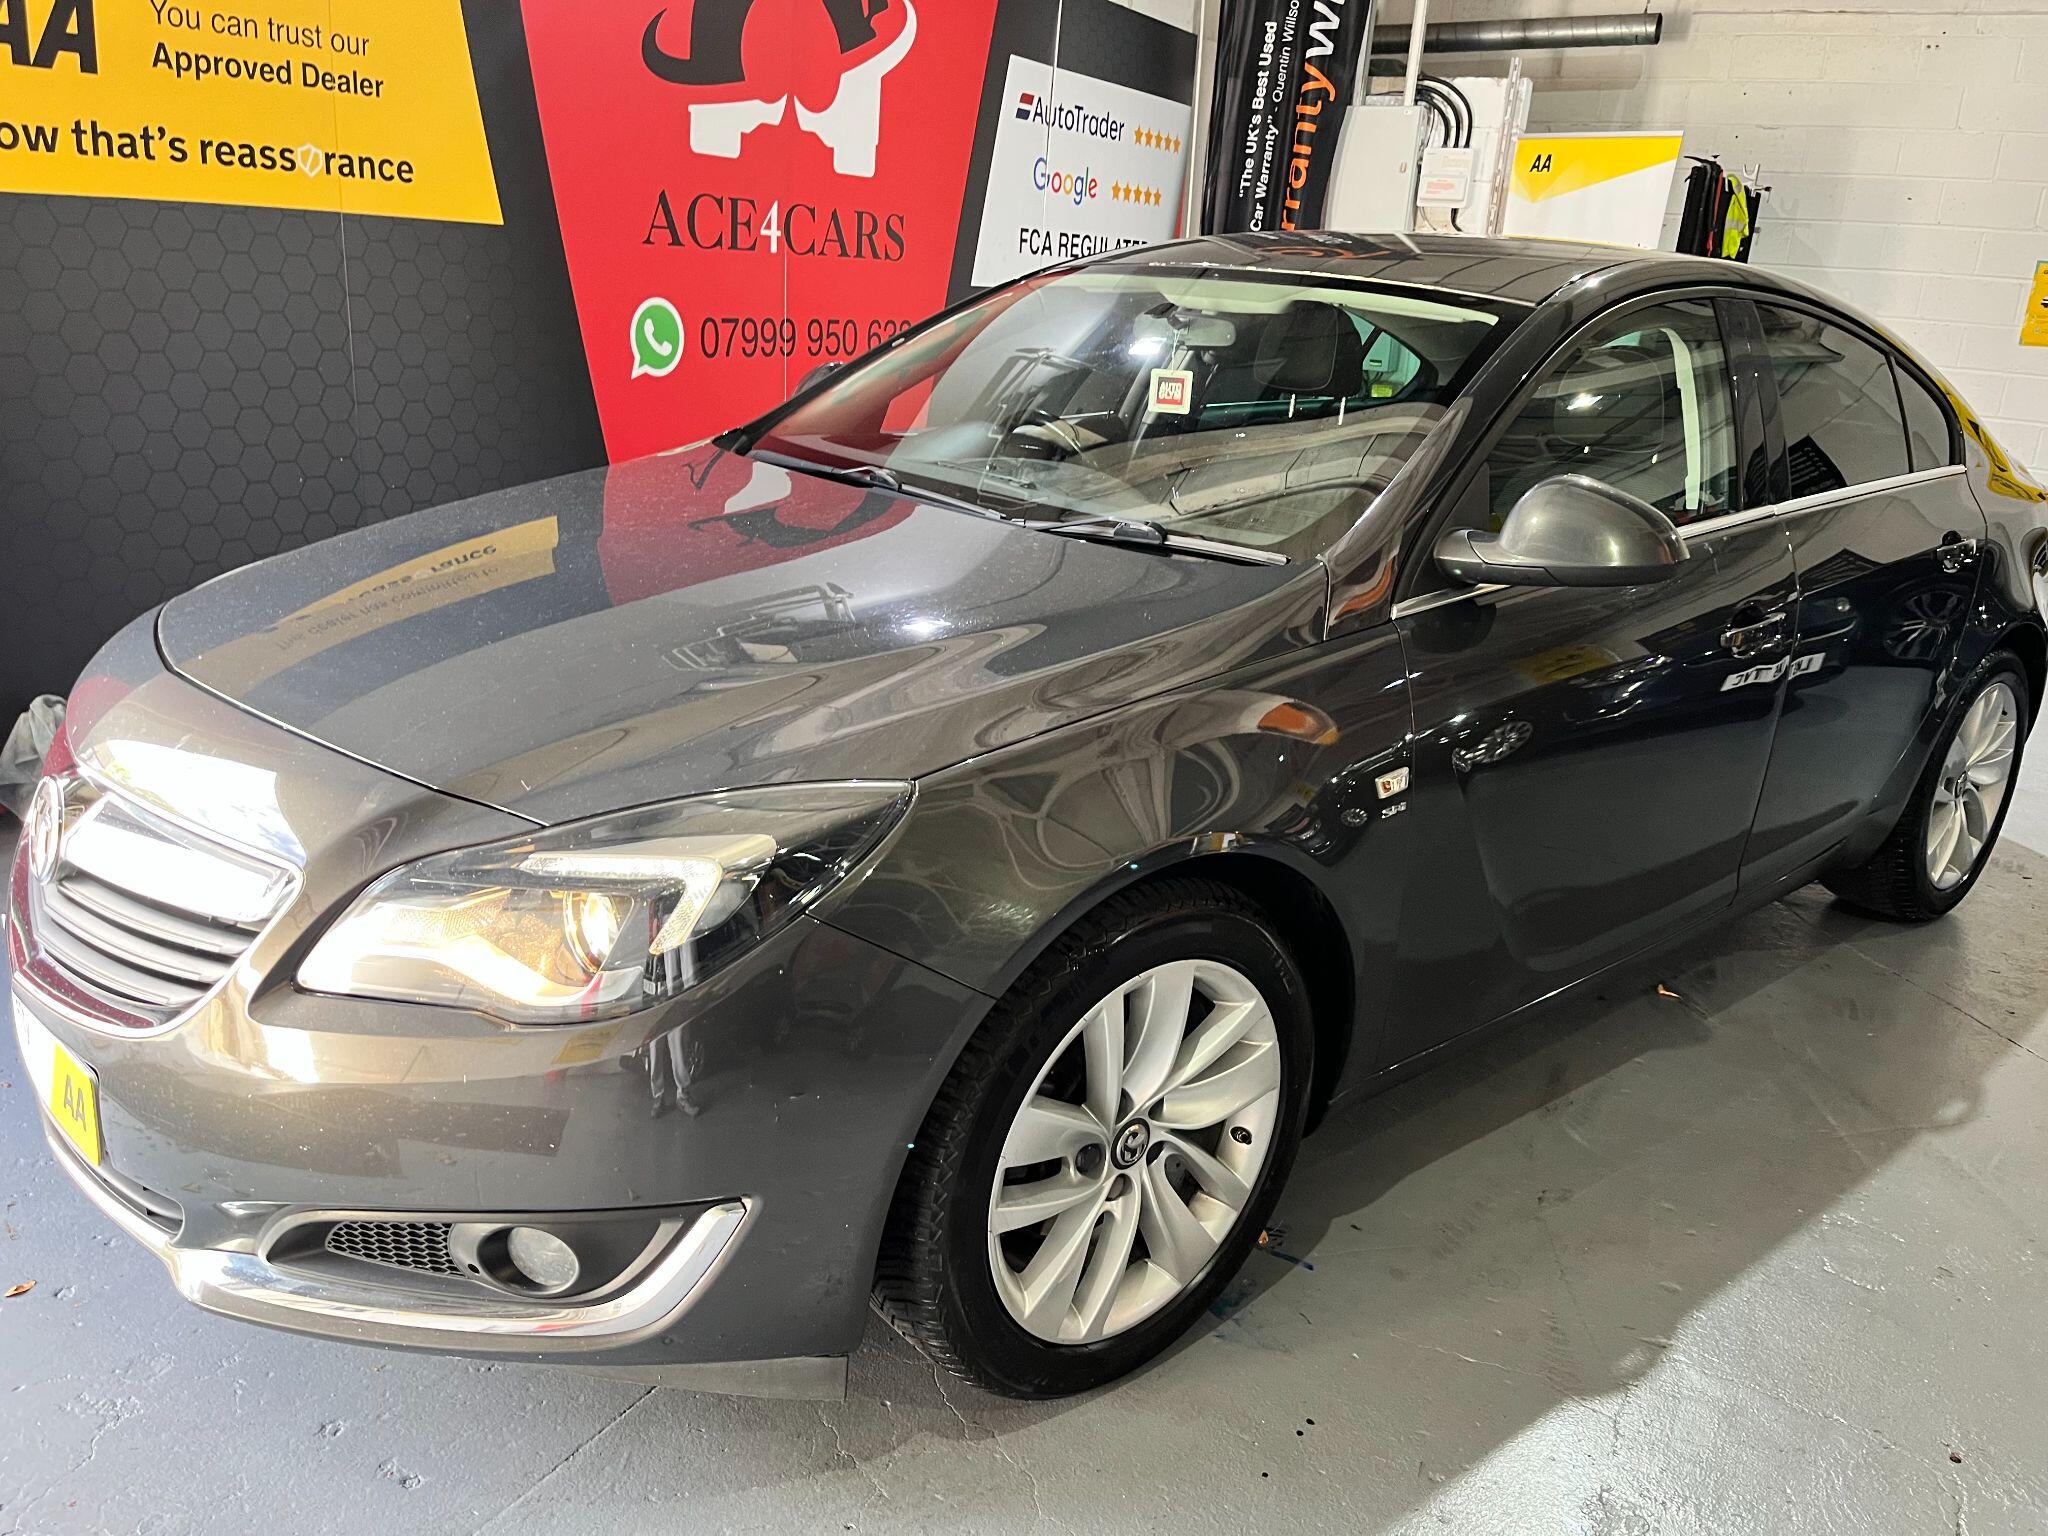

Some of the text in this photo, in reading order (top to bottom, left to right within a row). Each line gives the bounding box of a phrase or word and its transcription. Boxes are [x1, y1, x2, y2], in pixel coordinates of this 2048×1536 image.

[150, 0, 370, 57] You can trust our
[1258, 21, 1278, 66] Used
[1281, 0, 1300, 42] Willso
[152, 42, 384, 98] Approved Dealer
[1252, 69, 1270, 110] Best
[1272, 46, 1291, 103] Quentin
[1032, 97, 1125, 141] AutoTrader
[199, 137, 414, 183] reassrance
[1033, 157, 1098, 205] Google
[1529, 153, 1552, 173] AA
[642, 189, 905, 262] ACE4CARS
[1249, 202, 1265, 232] Car
[1019, 227, 1053, 257] FCA
[700, 317, 912, 358] 07999 950 63
[63, 1073, 87, 1133] AA
